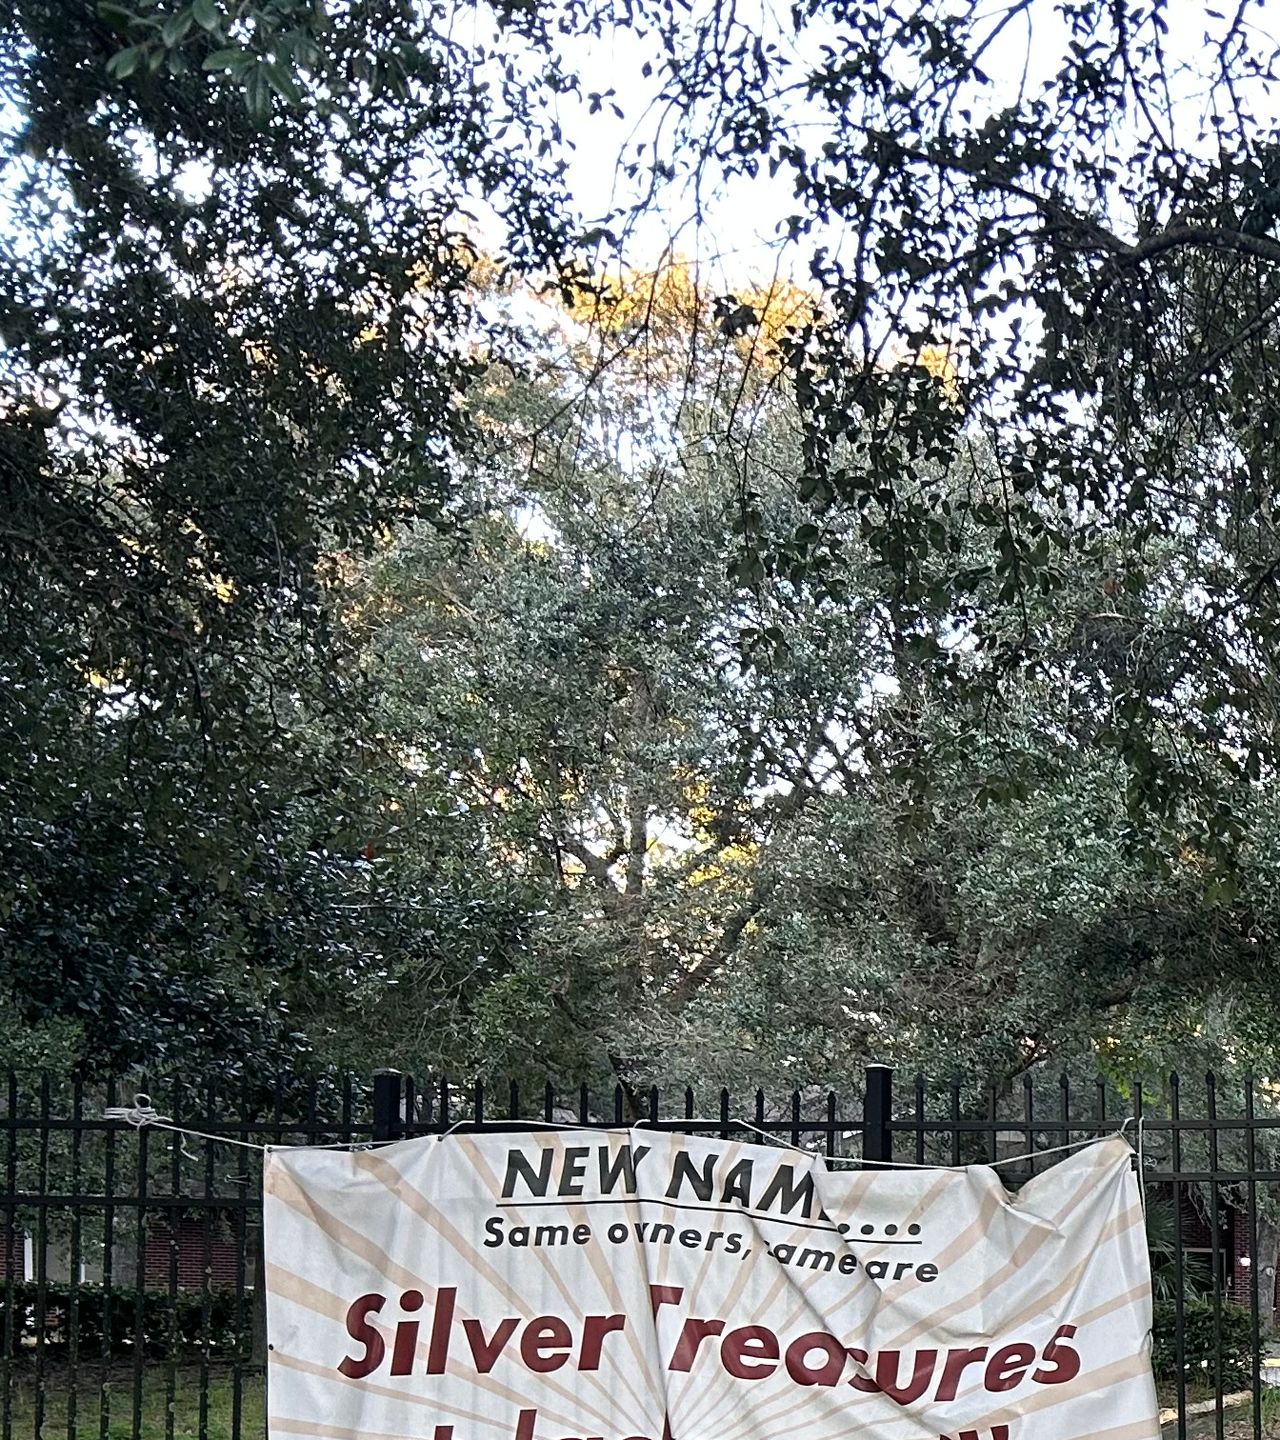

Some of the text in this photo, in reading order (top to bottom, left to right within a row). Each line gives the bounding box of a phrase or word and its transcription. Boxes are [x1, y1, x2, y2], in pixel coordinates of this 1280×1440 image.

[501, 1145, 651, 1198] NEW
[483, 1217, 591, 1248] Same
[763, 1239, 858, 1272] ame
[337, 1287, 626, 1379] Silver
